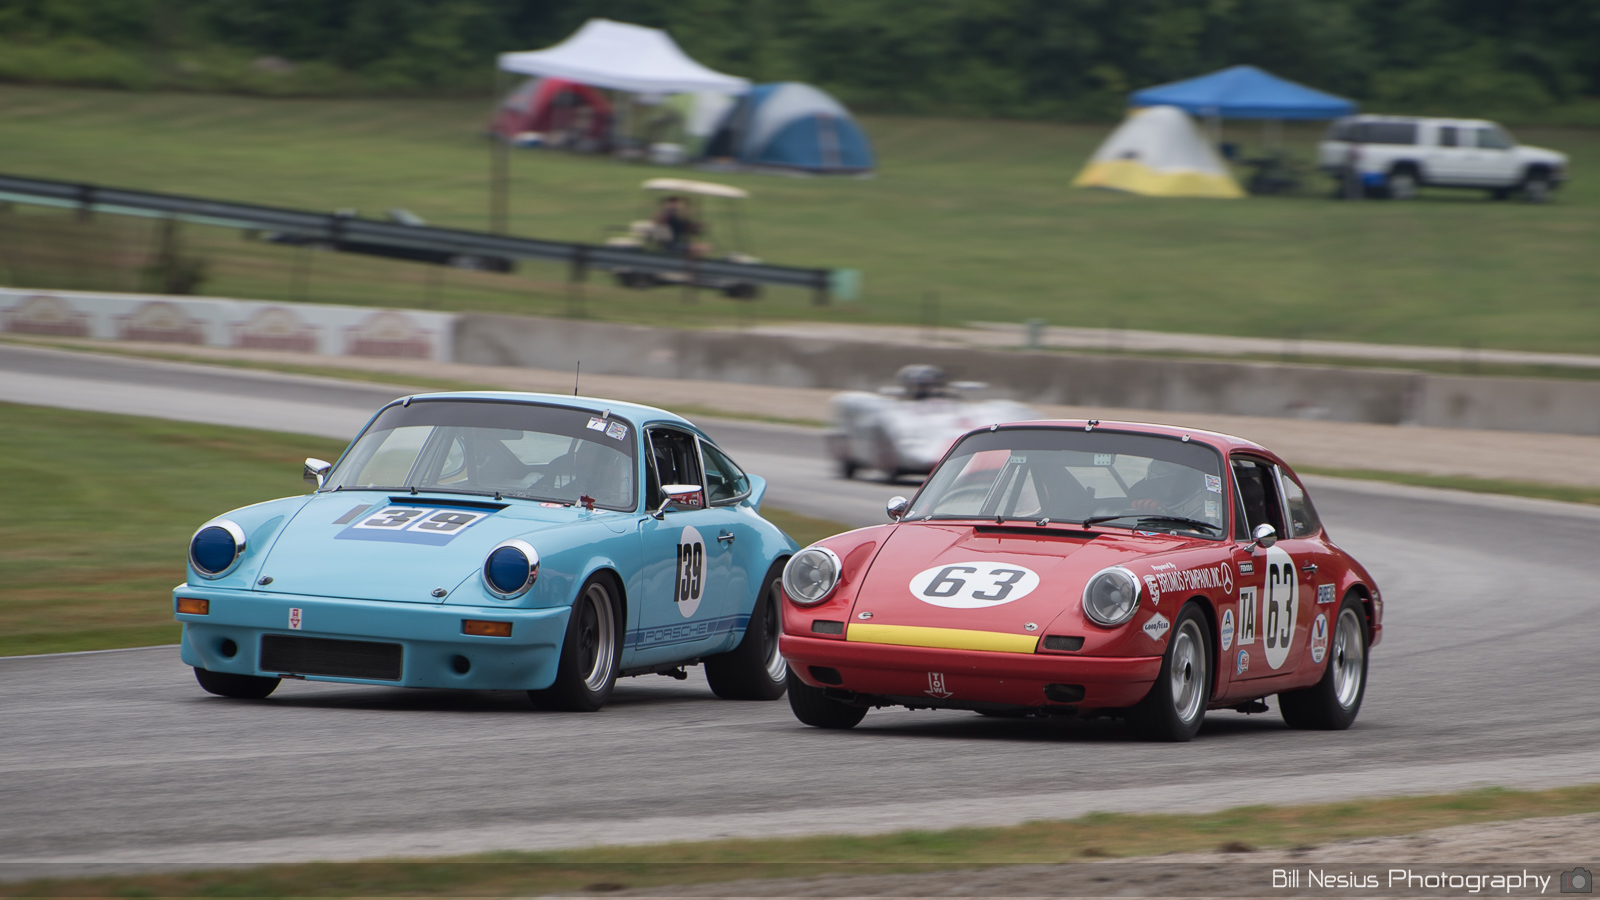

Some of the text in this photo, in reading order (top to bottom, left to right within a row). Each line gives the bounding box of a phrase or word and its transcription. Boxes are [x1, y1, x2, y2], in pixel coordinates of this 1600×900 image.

[332, 504, 477, 531] 139
[674, 542, 702, 602] 139
[923, 566, 1026, 601] 63
[1241, 592, 1254, 639] TA
[1267, 563, 1293, 649] 63
[645, 622, 707, 642] PORSCHE
[932, 673, 943, 694] TOW
